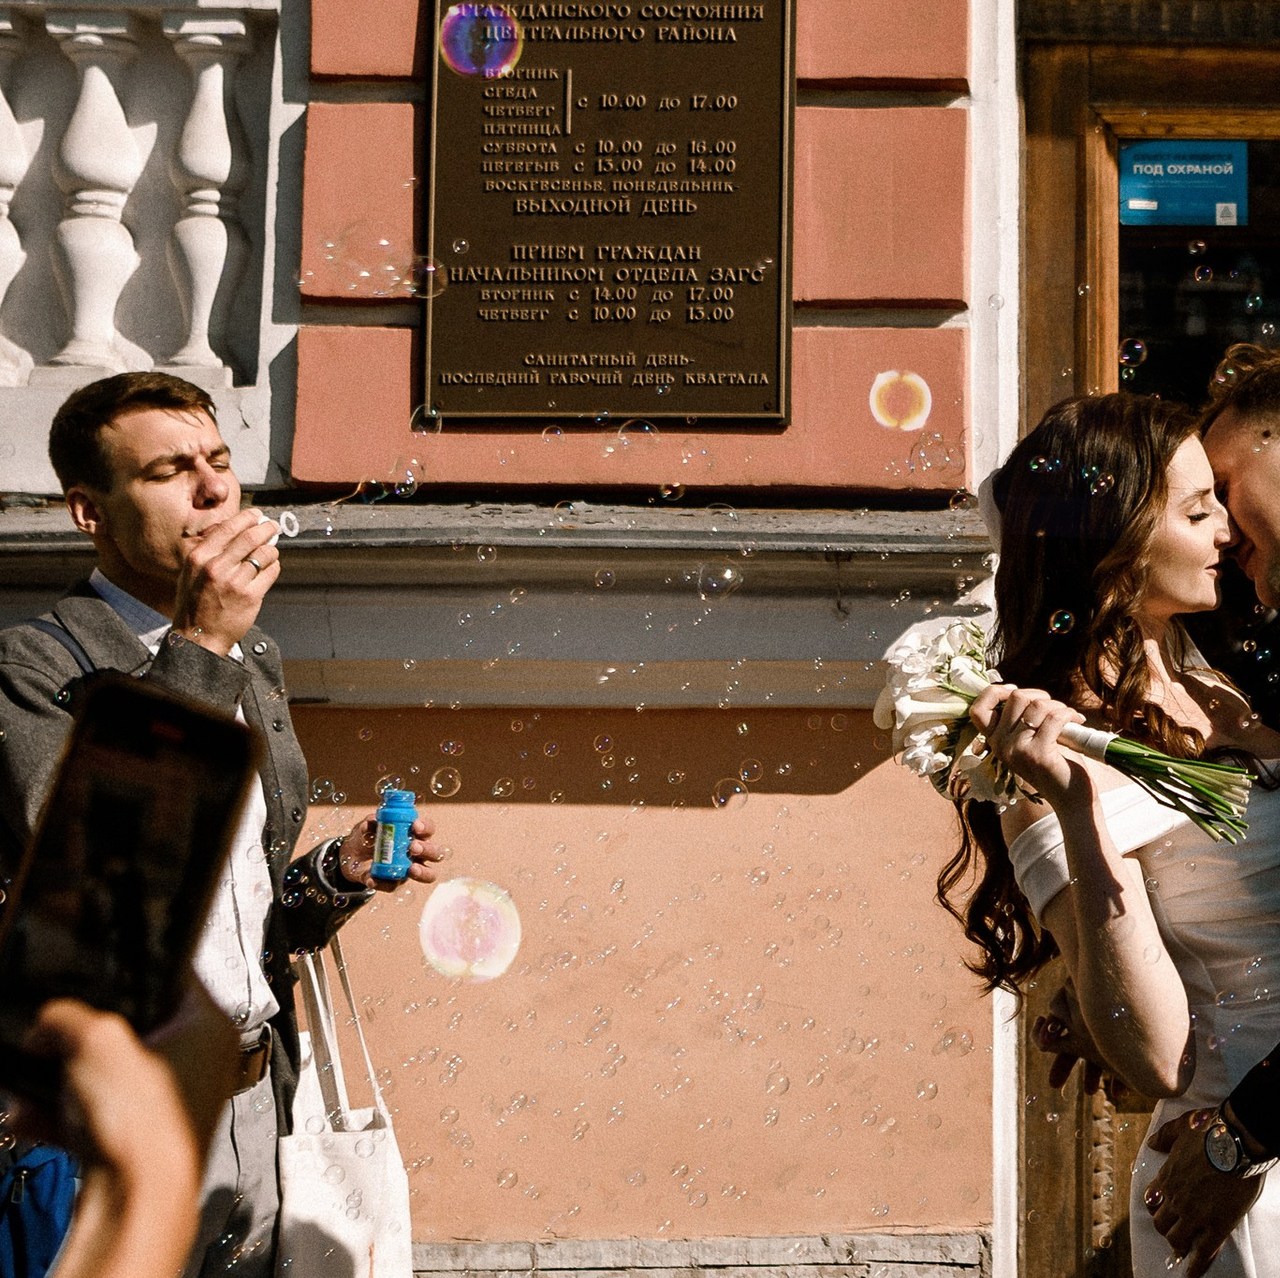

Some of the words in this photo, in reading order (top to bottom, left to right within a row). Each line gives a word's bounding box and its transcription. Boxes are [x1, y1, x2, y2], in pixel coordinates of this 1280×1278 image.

[461, 4, 631, 20] ГРАЖДАНСКОГО
[641, 5, 764, 20] СОСТОЯНИЯ
[485, 25, 645, 41] ЦЕНТРАЛЬНОГО
[658, 23, 737, 41] РАЙОНА
[485, 68, 559, 80] ВТОРНИК
[484, 87, 538, 100] СРЕДА
[601, 94, 646, 108] 10.00
[658, 97, 680, 110] до
[692, 95, 738, 109] 17.00
[483, 105, 555, 117] ЧЕТВЕРГ
[482, 124, 560, 136] ПЯТНИЦА
[483, 142, 557, 154] СУББОТА
[599, 140, 643, 154] 10.00
[655, 142, 676, 155] до
[690, 140, 737, 154] 16.00
[482, 161, 559, 172] ПЕРЕРЫВ
[654, 161, 676, 174] до
[690, 159, 736, 172] 14.00
[1133, 164, 1164, 176] ПОД
[1167, 163, 1233, 175] ОХРАНОЙ
[515, 195, 631, 214] ВЫХОДНОЙ
[642, 198, 697, 214] ДЕНЬ
[512, 245, 584, 260] ПРИЕМ
[598, 245, 701, 262] ГРАЖДАН
[451, 267, 604, 282] НАЧАЛЬНИКОМ
[616, 267, 698, 284] ОТДЕЛА
[711, 267, 764, 282] ЗАГС
[481, 289, 555, 301] ВТОРНИК
[594, 287, 637, 301] 14.00
[652, 289, 673, 303] до
[689, 288, 734, 301] 17.00
[479, 308, 549, 320] ЧЕТВЕРГ
[594, 307, 636, 320] 10.00
[650, 308, 671, 322] до
[524, 352, 636, 367] САНИТАРНЫЙ
[644, 354, 695, 367] ДЕНЬ-
[441, 371, 540, 385] ПОСЛЕДНИЙ
[549, 371, 623, 385] РАБОЧИЙ
[632, 372, 675, 386] ДЕНЬ
[685, 373, 769, 385] КВАРТАЛА
